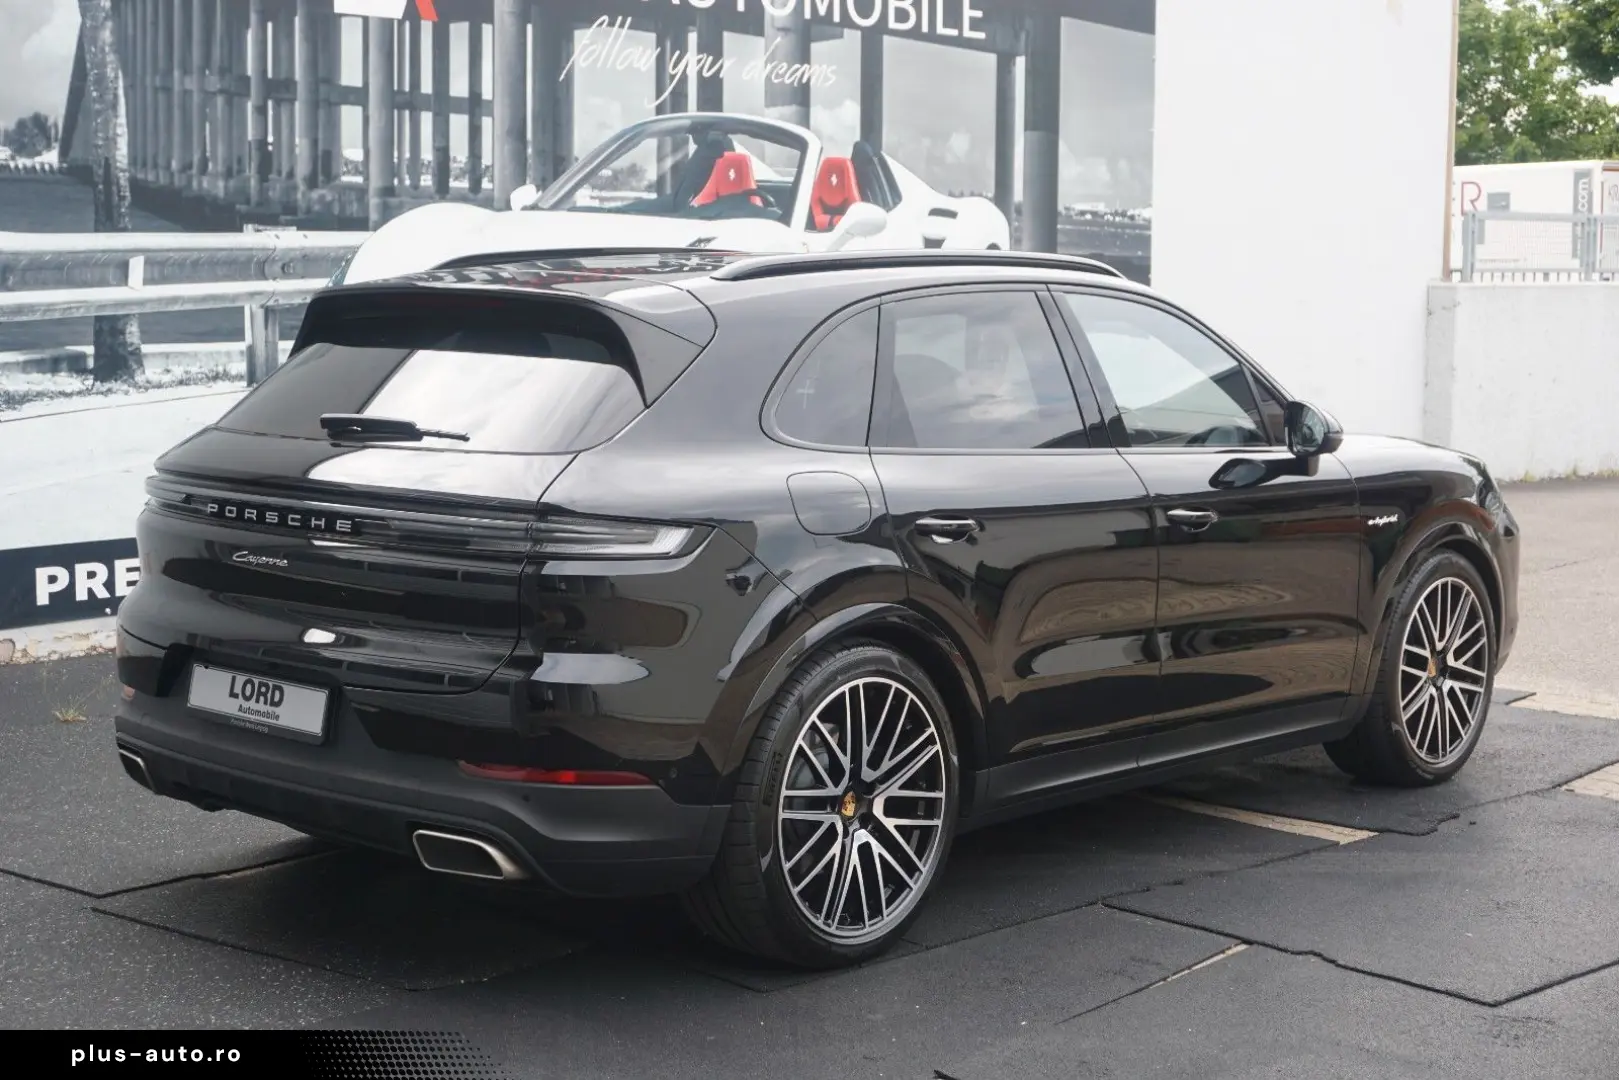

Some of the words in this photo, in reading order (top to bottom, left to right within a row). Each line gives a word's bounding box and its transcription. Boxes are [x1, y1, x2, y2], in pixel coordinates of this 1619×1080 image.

[559, 15, 661, 82] follow
[644, 46, 731, 108] your
[742, 36, 837, 87] dreams
[207, 503, 352, 532] PORSCHE
[232, 551, 288, 567] Cayenne
[228, 675, 285, 708] LORD
[237, 704, 280, 721] Automobile
